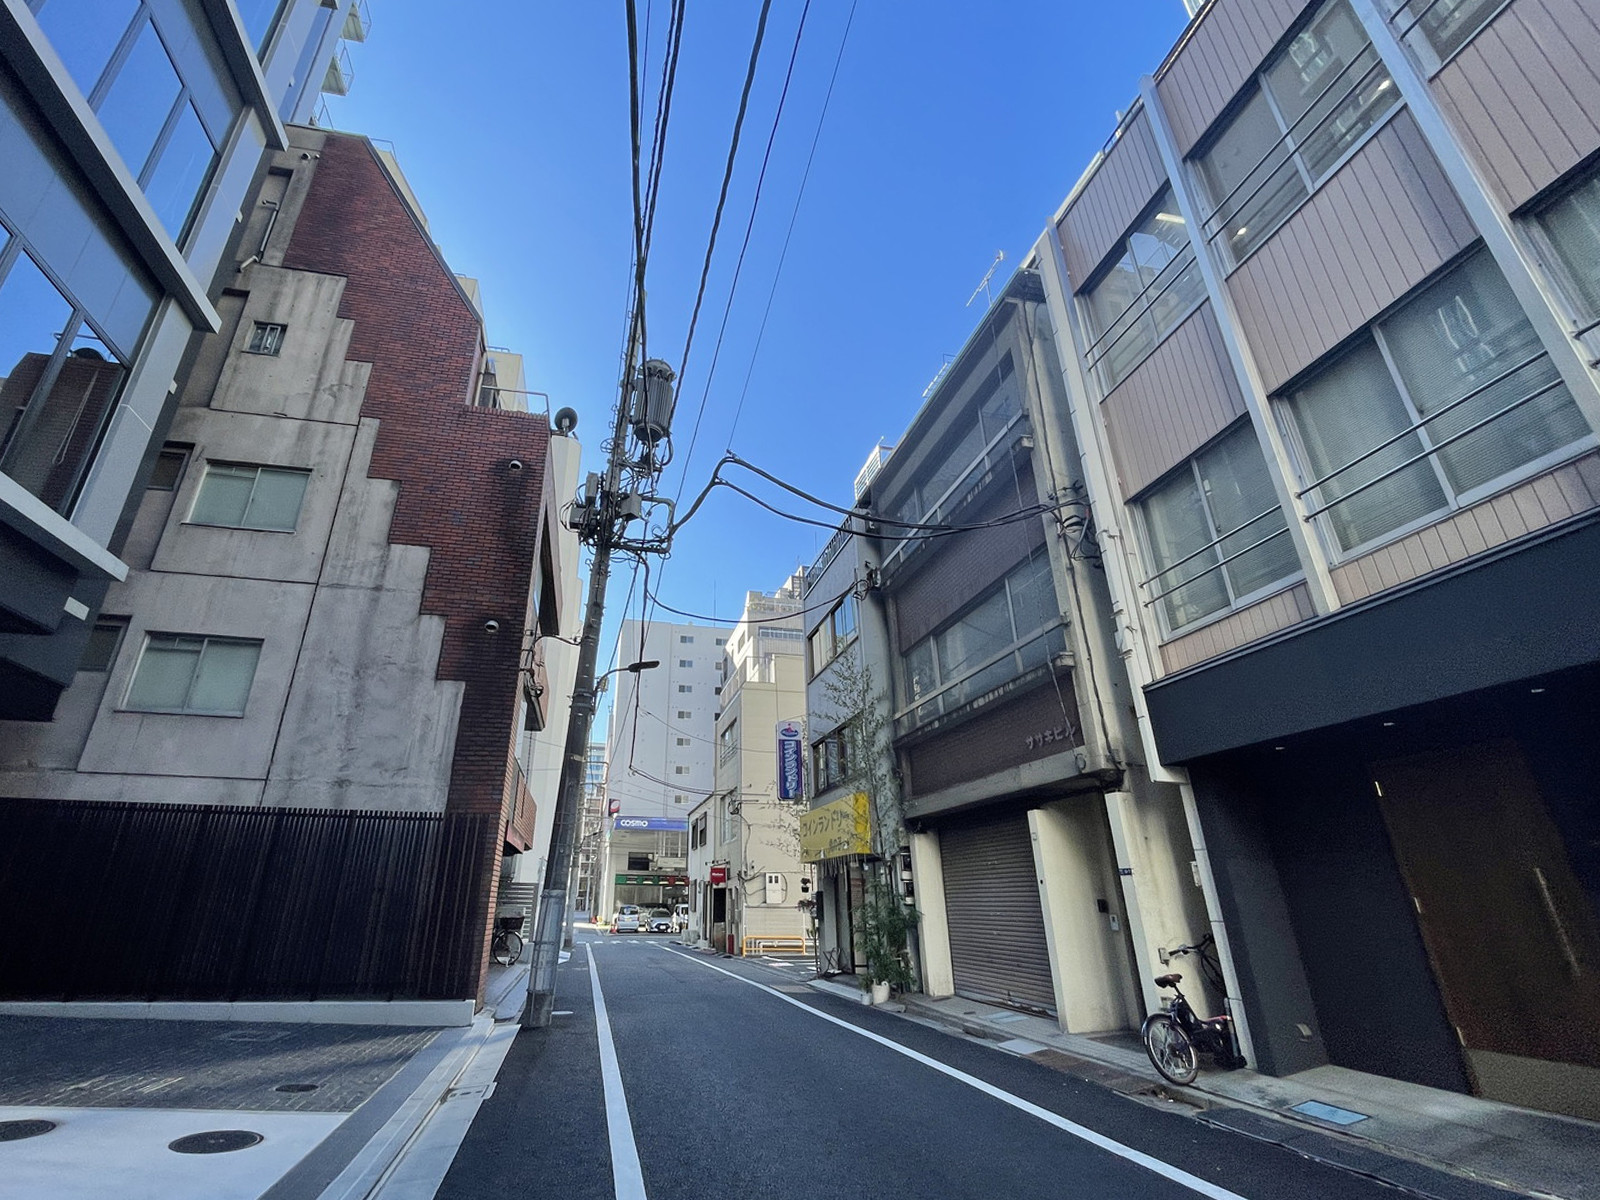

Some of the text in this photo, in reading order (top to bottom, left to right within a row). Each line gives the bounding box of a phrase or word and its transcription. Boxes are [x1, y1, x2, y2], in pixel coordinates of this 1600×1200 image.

[784, 740, 798, 798] コインランドリー
[620, 819, 648, 827] COSMO
